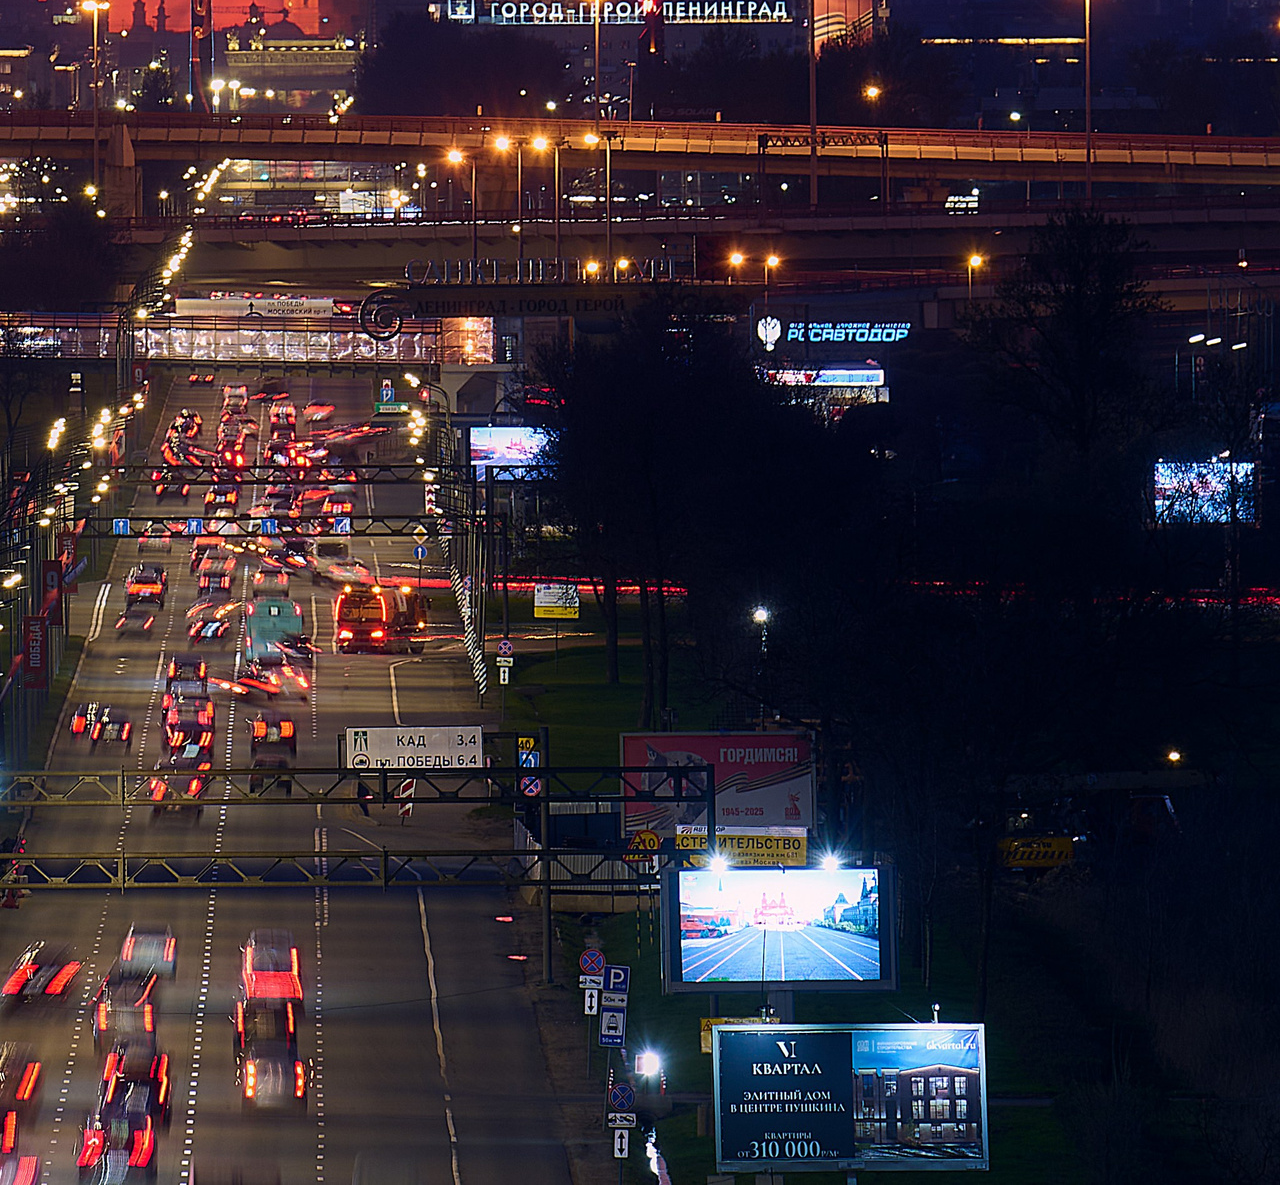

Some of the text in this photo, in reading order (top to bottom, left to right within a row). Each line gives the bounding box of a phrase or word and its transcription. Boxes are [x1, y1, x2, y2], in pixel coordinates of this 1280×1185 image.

[416, 295, 625, 314] ЛЕНИНГРАД ГОРОД ГЕРОЙ
[30, 621, 43, 667] ПОБЕДА!
[397, 734, 477, 748] КАД 3,4
[376, 755, 477, 768] пл. ПОБЕДЫ 6,4
[720, 748, 798, 764] ГОРДИМСЯ!
[681, 837, 801, 850] СТРИТЕЛЬСТВО
[926, 1039, 976, 1050] 6kvartal.ru
[752, 1063, 822, 1076] КВАРТАЛ
[743, 1089, 831, 1102] ЭЛИТНЫЙ ДОМ
[730, 1103, 846, 1115] В ЦЕНТРЕ ПУШКИНА
[764, 1131, 812, 1140] КВАРТИРЫ
